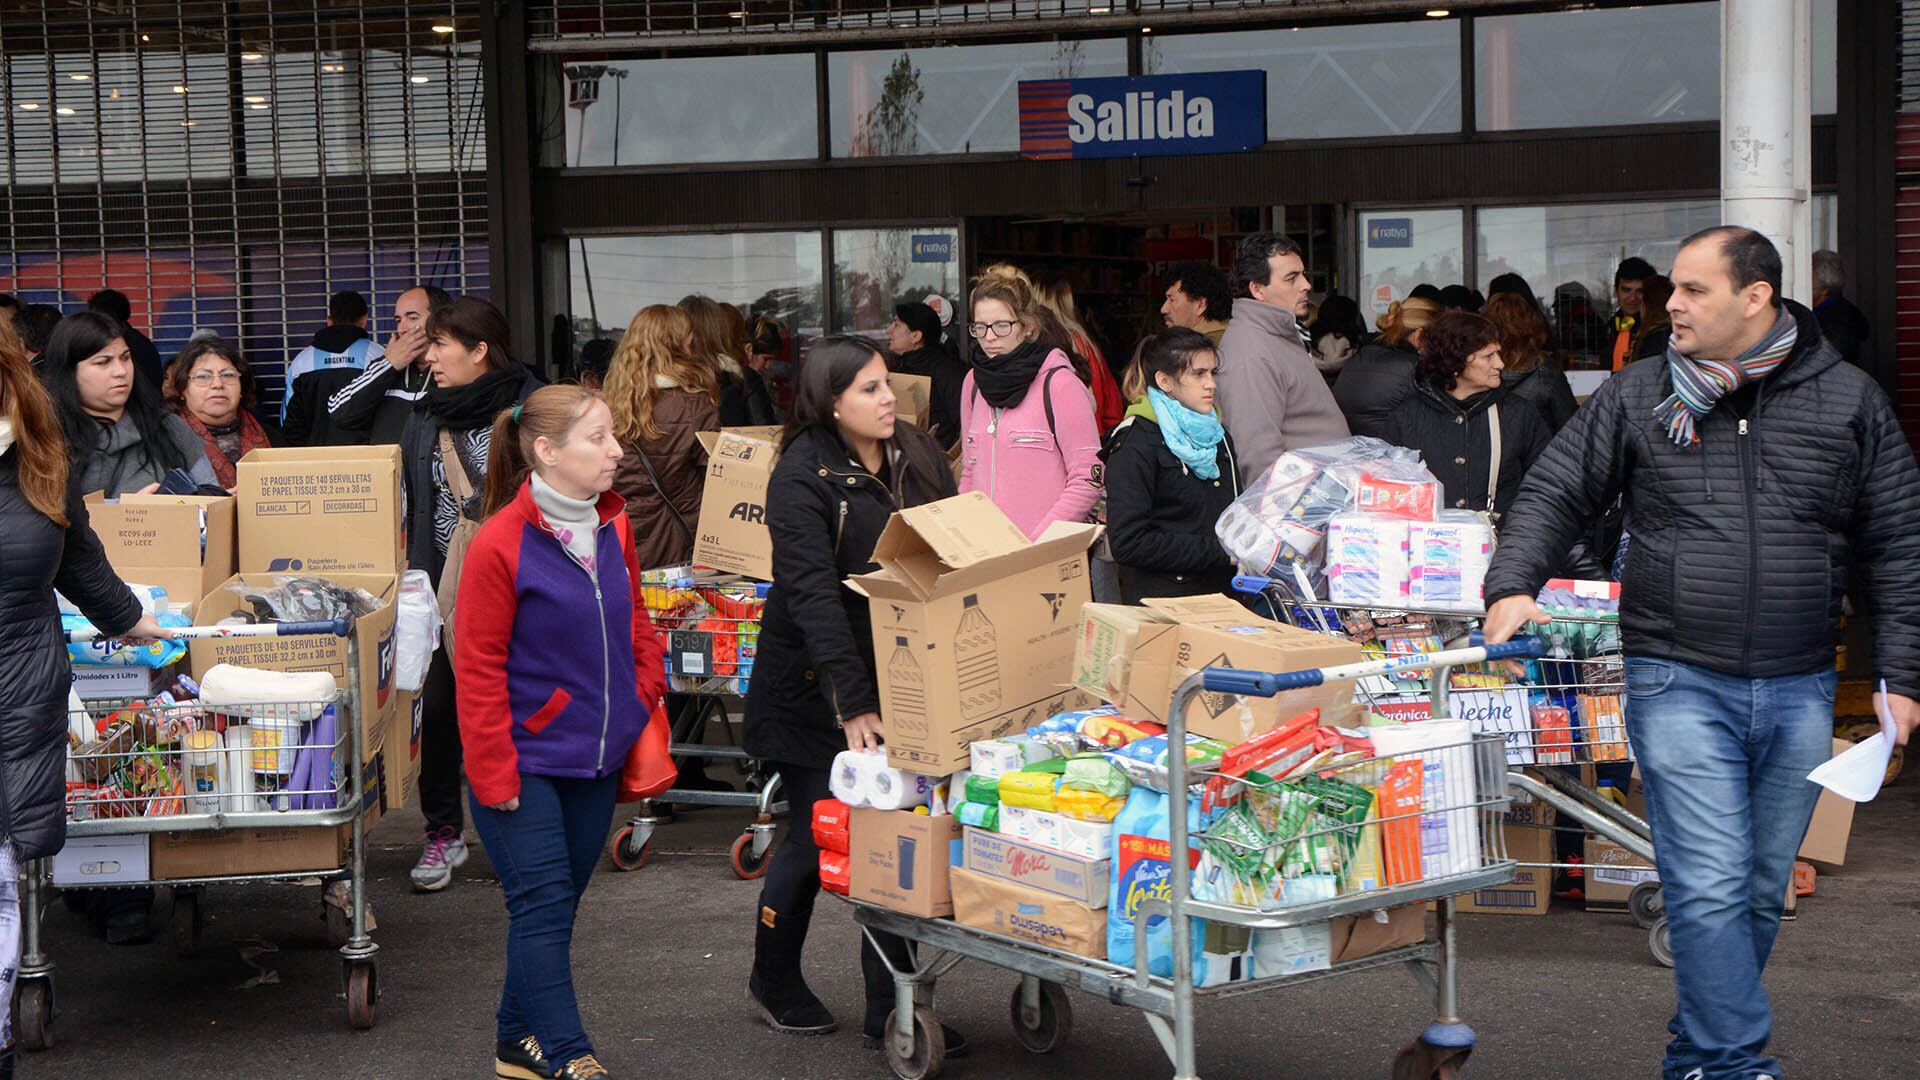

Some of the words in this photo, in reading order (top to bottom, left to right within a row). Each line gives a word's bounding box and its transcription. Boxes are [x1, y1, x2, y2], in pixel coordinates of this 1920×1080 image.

[1068, 90, 1214, 143] Salida
[1379, 228, 1408, 239] nativa
[923, 243, 948, 253] nativa
[324, 356, 355, 365] ARGENTINA
[260, 477, 268, 486] 12
[270, 475, 304, 486] PAQUETES
[306, 475, 314, 484] DE
[316, 475, 328, 484] 140
[329, 474, 372, 483] SERVILLETAS
[262, 487, 271, 496] DE
[272, 486, 292, 496] PAPEL
[294, 485, 318, 496] TISSUE
[319, 485, 334, 495] 32,2
[335, 486, 345, 494] cm
[351, 484, 360, 493] 30
[258, 504, 287, 513] BLANCAS
[326, 502, 362, 510] DECORADAS
[307, 558, 338, 566] Papelera
[215, 646, 224, 656] 12
[225, 642, 263, 655] PAQUETES
[264, 642, 274, 652] DE
[275, 641, 289, 651] 140
[290, 637, 337, 650] SERVILLETAS
[674, 633, 709, 650] 5197
[228, 654, 252, 665] PAPEL
[253, 653, 279, 664] TISSUE
[280, 652, 298, 662] 32,2
[299, 653, 309, 661] cm
[315, 650, 325, 660] 30
[326, 651, 337, 659] cm
[78, 673, 109, 681] Unidades
[1459, 697, 1513, 721] leche
